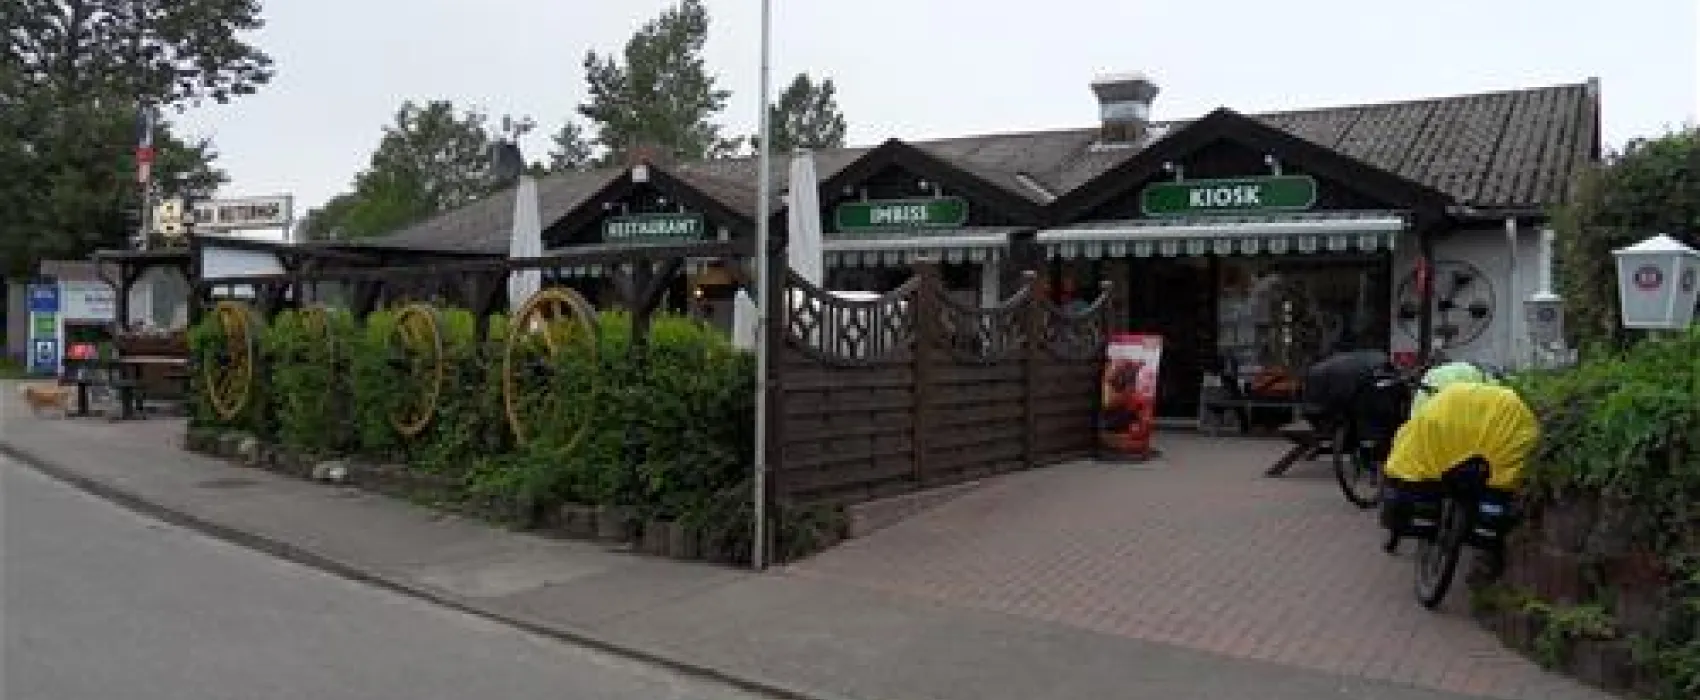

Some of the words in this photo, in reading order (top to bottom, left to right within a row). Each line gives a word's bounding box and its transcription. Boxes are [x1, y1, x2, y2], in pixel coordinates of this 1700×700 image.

[1189, 185, 1261, 207] KIOSK
[869, 205, 929, 225] IMBISS
[604, 219, 698, 237] RESTAURANT
